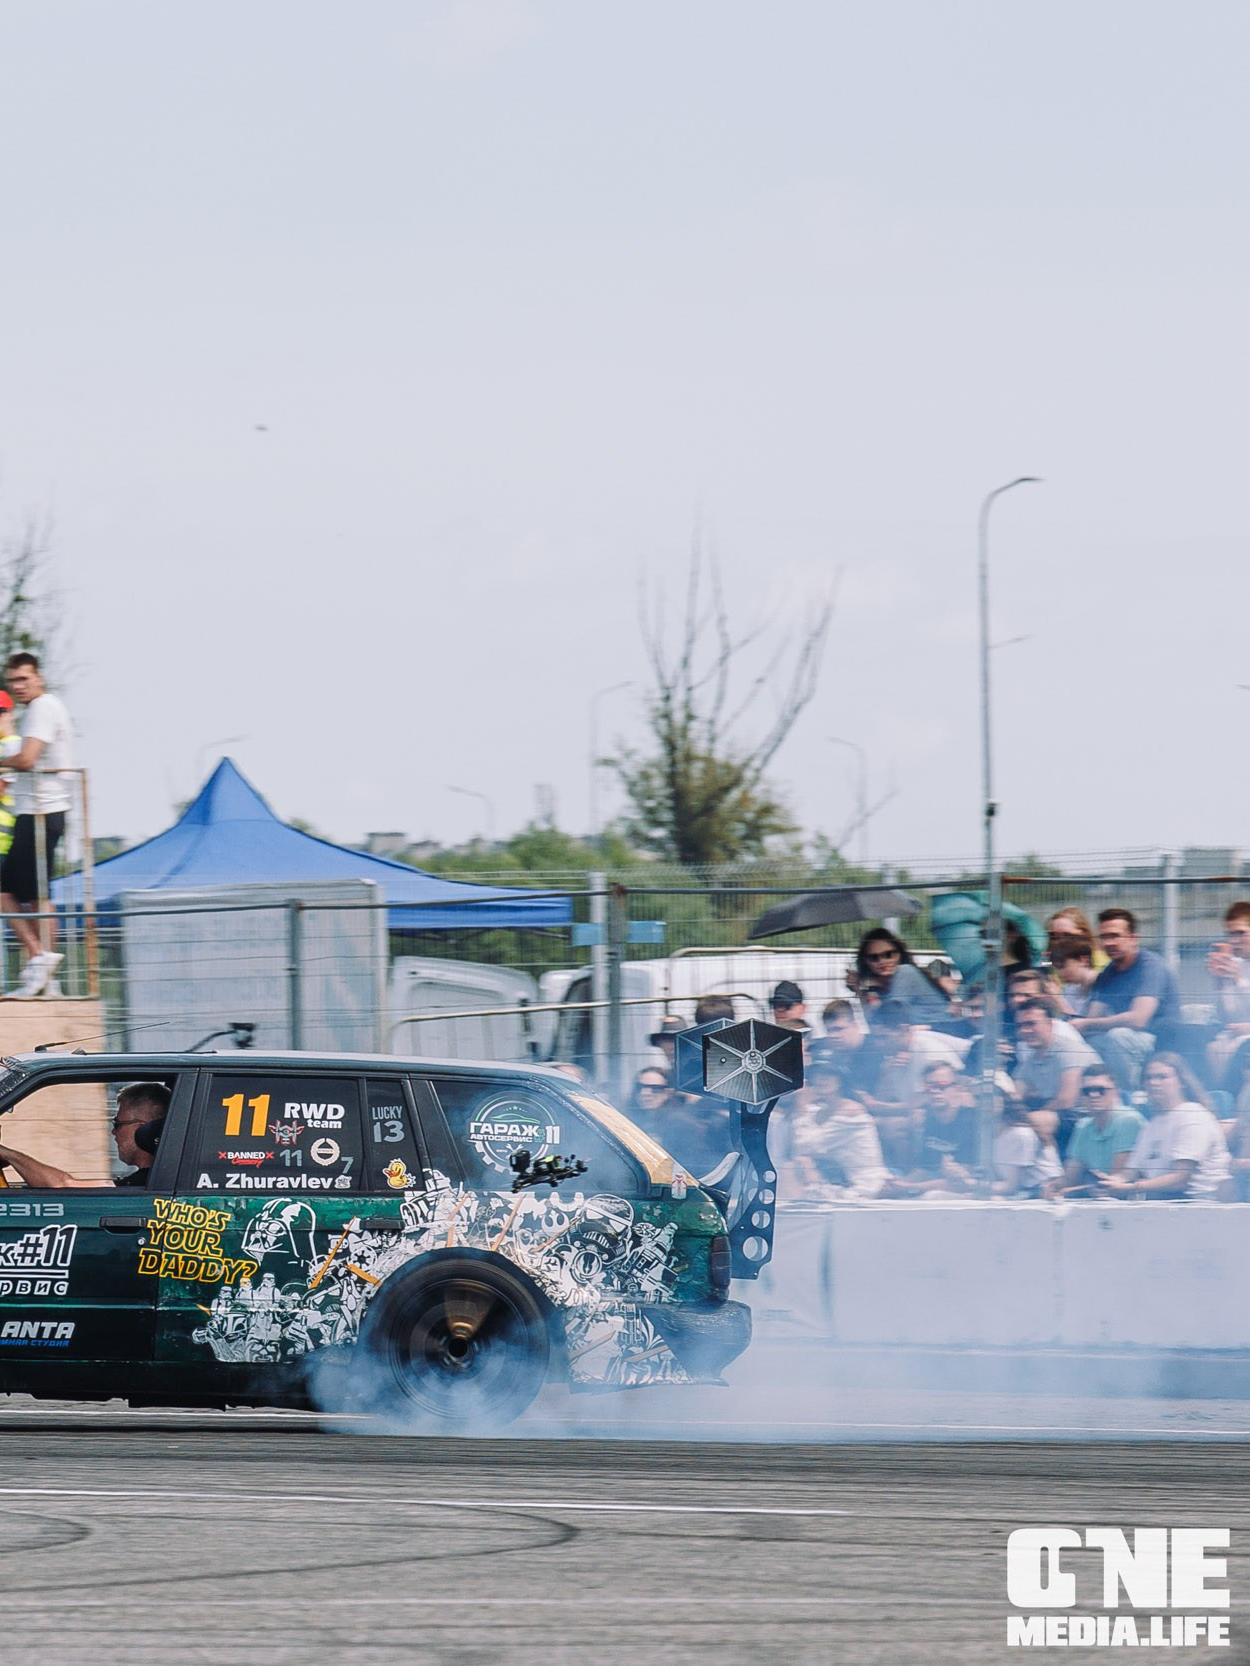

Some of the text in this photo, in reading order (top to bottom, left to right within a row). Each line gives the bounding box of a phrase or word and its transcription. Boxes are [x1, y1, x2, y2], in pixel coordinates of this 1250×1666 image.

[222, 1093, 271, 1137] 11
[283, 1102, 346, 1120] RWD
[371, 1105, 403, 1120] LUCKY
[307, 1119, 343, 1129] team
[373, 1120, 405, 1143] 13
[469, 1122, 540, 1137] ГАРАЖ
[470, 1133, 533, 1143] АВТОСЕРВИС
[279, 1149, 303, 1167] 11
[341, 1156, 354, 1174] 7
[196, 1173, 334, 1189] A. Zhuravlev
[154, 1198, 231, 1232] WHO'S
[147, 1219, 223, 1257] YOUR
[137, 1248, 259, 1285] DADDY?
